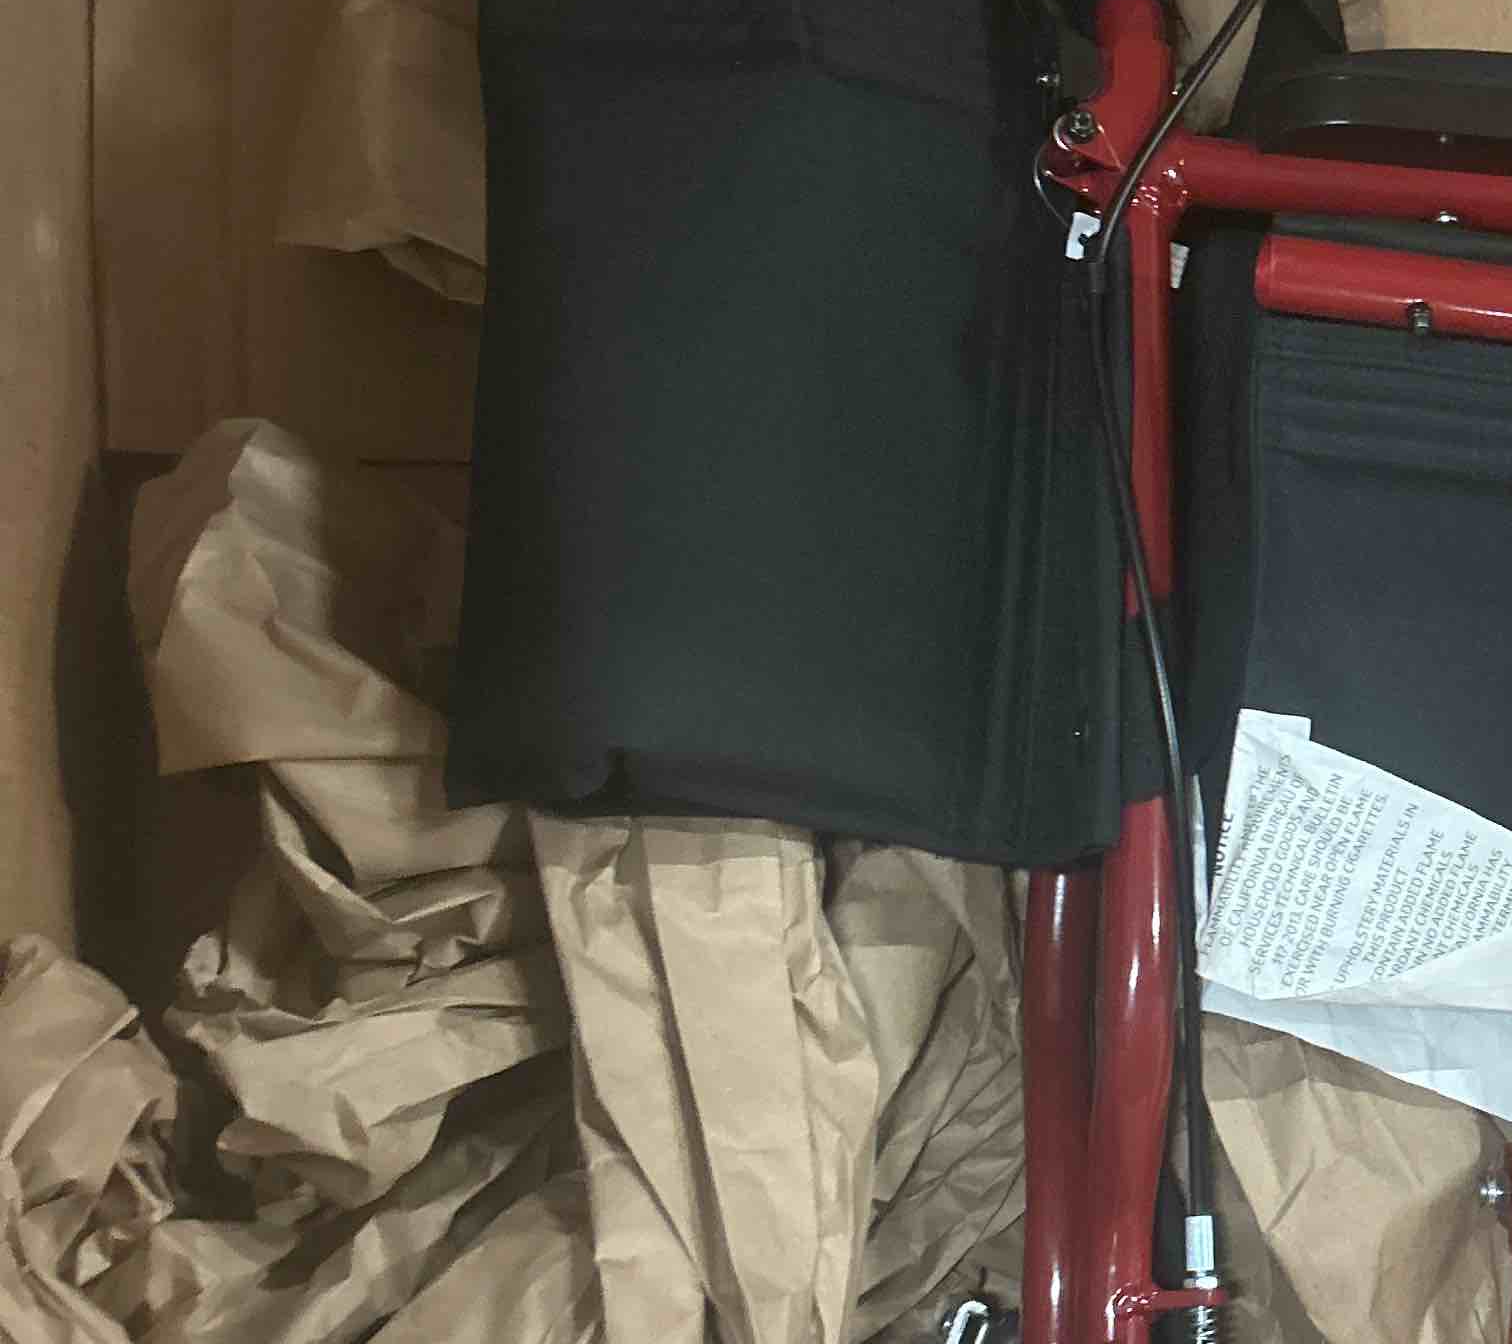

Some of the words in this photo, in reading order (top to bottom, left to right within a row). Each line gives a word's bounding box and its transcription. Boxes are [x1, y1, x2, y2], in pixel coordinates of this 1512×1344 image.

[1217, 926, 1235, 948] OF
[1226, 843, 1271, 928] CALIFORNIA
[1260, 788, 1297, 845] BUREAU
[1288, 771, 1305, 789] OF
[1238, 860, 1283, 949] HOUSEHOLD
[1273, 811, 1303, 862] GOODS
[1295, 784, 1321, 816] AND
[1247, 908, 1283, 975] SERVICES
[1273, 834, 1311, 909] TECHNICAL
[1302, 771, 1344, 835] BULLETIN
[1279, 912, 1320, 988] EXERCISED
[1309, 872, 1334, 912] NEAR
[1322, 834, 1350, 873] OPEN
[1342, 786, 1372, 835] FLAME
[1293, 869, 1317, 907] CARE
[1306, 814, 1343, 869] SHOULD
[1335, 794, 1353, 815] BE
[1333, 894, 1379, 985] UPHOLSTERY
[1370, 819, 1411, 895] MATERIALS
[1402, 801, 1419, 819] IN
[1395, 875, 1424, 925] ADDED
[1414, 827, 1444, 876] FLAME
[1413, 848, 1454, 927] CHEMICALS
[1450, 829, 1478, 878] FLAME
[1482, 846, 1503, 878] HAS
[1300, 937, 1329, 976] WITH
[1318, 873, 1351, 938] BURNING
[1361, 931, 1385, 965] THIS
[1374, 866, 1409, 932] PRODUCT
[1420, 926, 1439, 949] NO
[1429, 877, 1458, 927] ADDED
[1441, 861, 1480, 940] CHEMICALS
